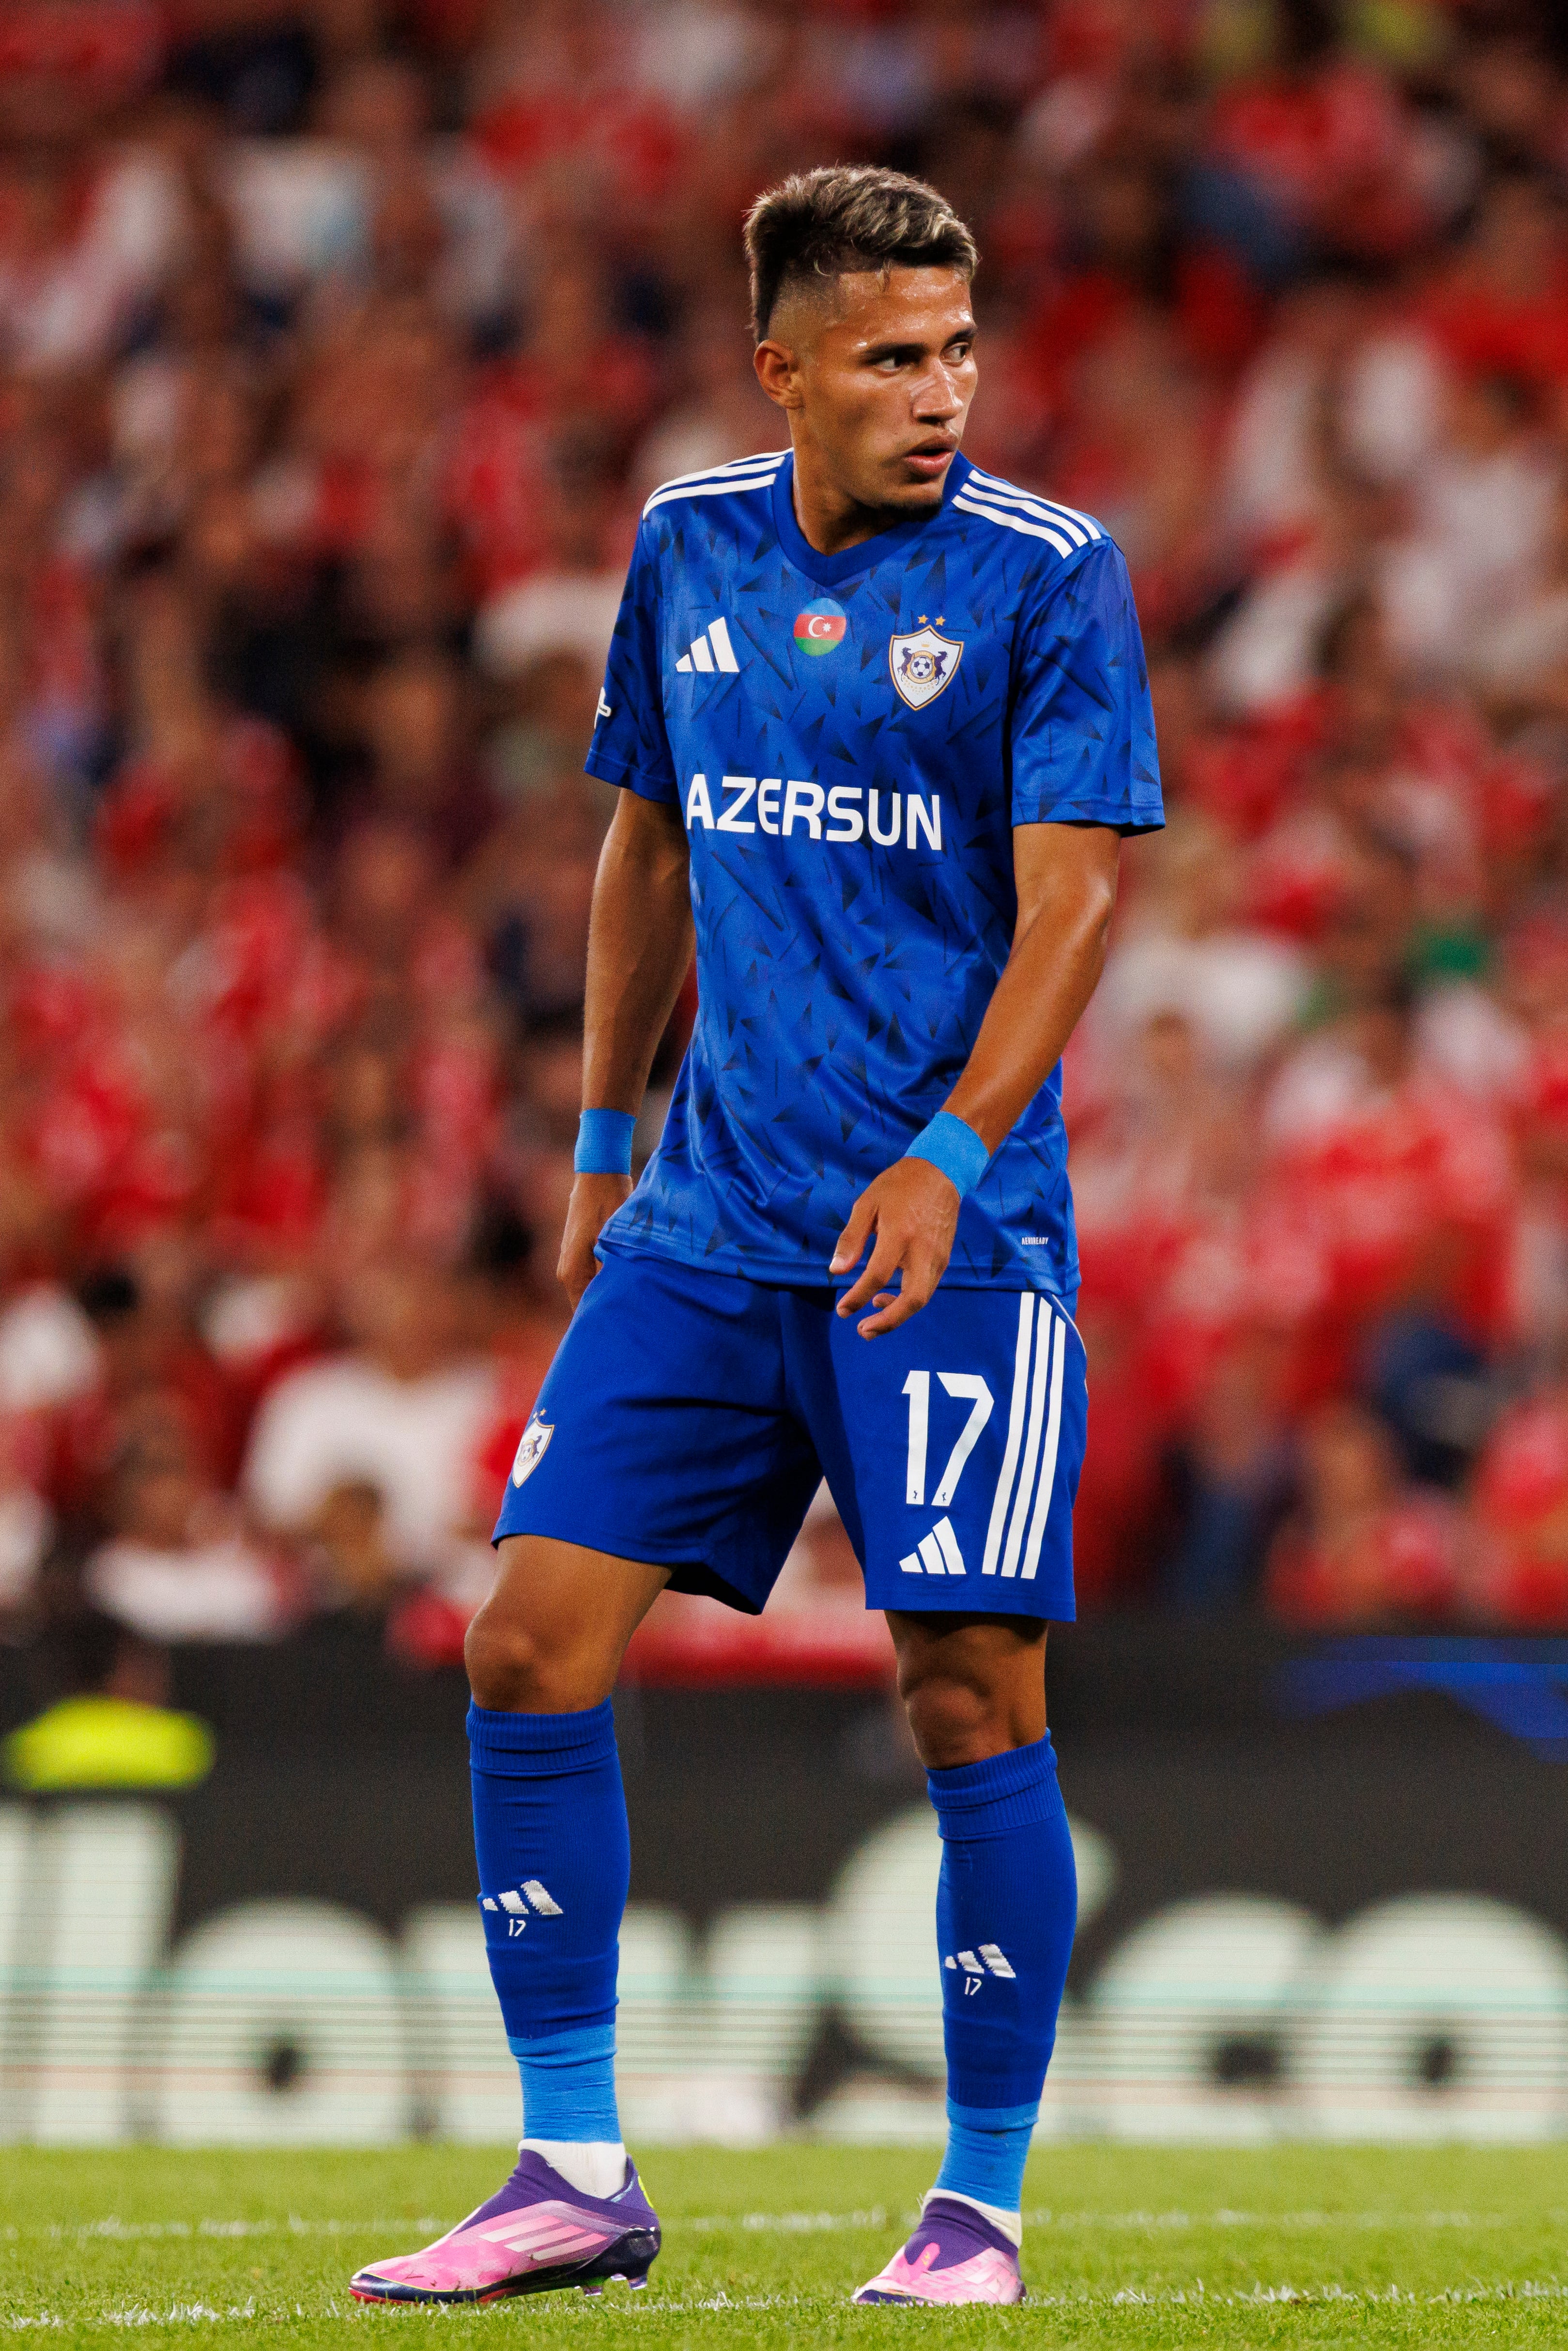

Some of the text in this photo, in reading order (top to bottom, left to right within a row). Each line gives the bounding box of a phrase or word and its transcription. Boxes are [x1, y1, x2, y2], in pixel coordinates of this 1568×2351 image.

[687, 774, 941, 850] AZERSUN
[902, 1370, 995, 1506] 17
[509, 1919, 526, 1936] 17
[965, 1977, 982, 1996] 17
